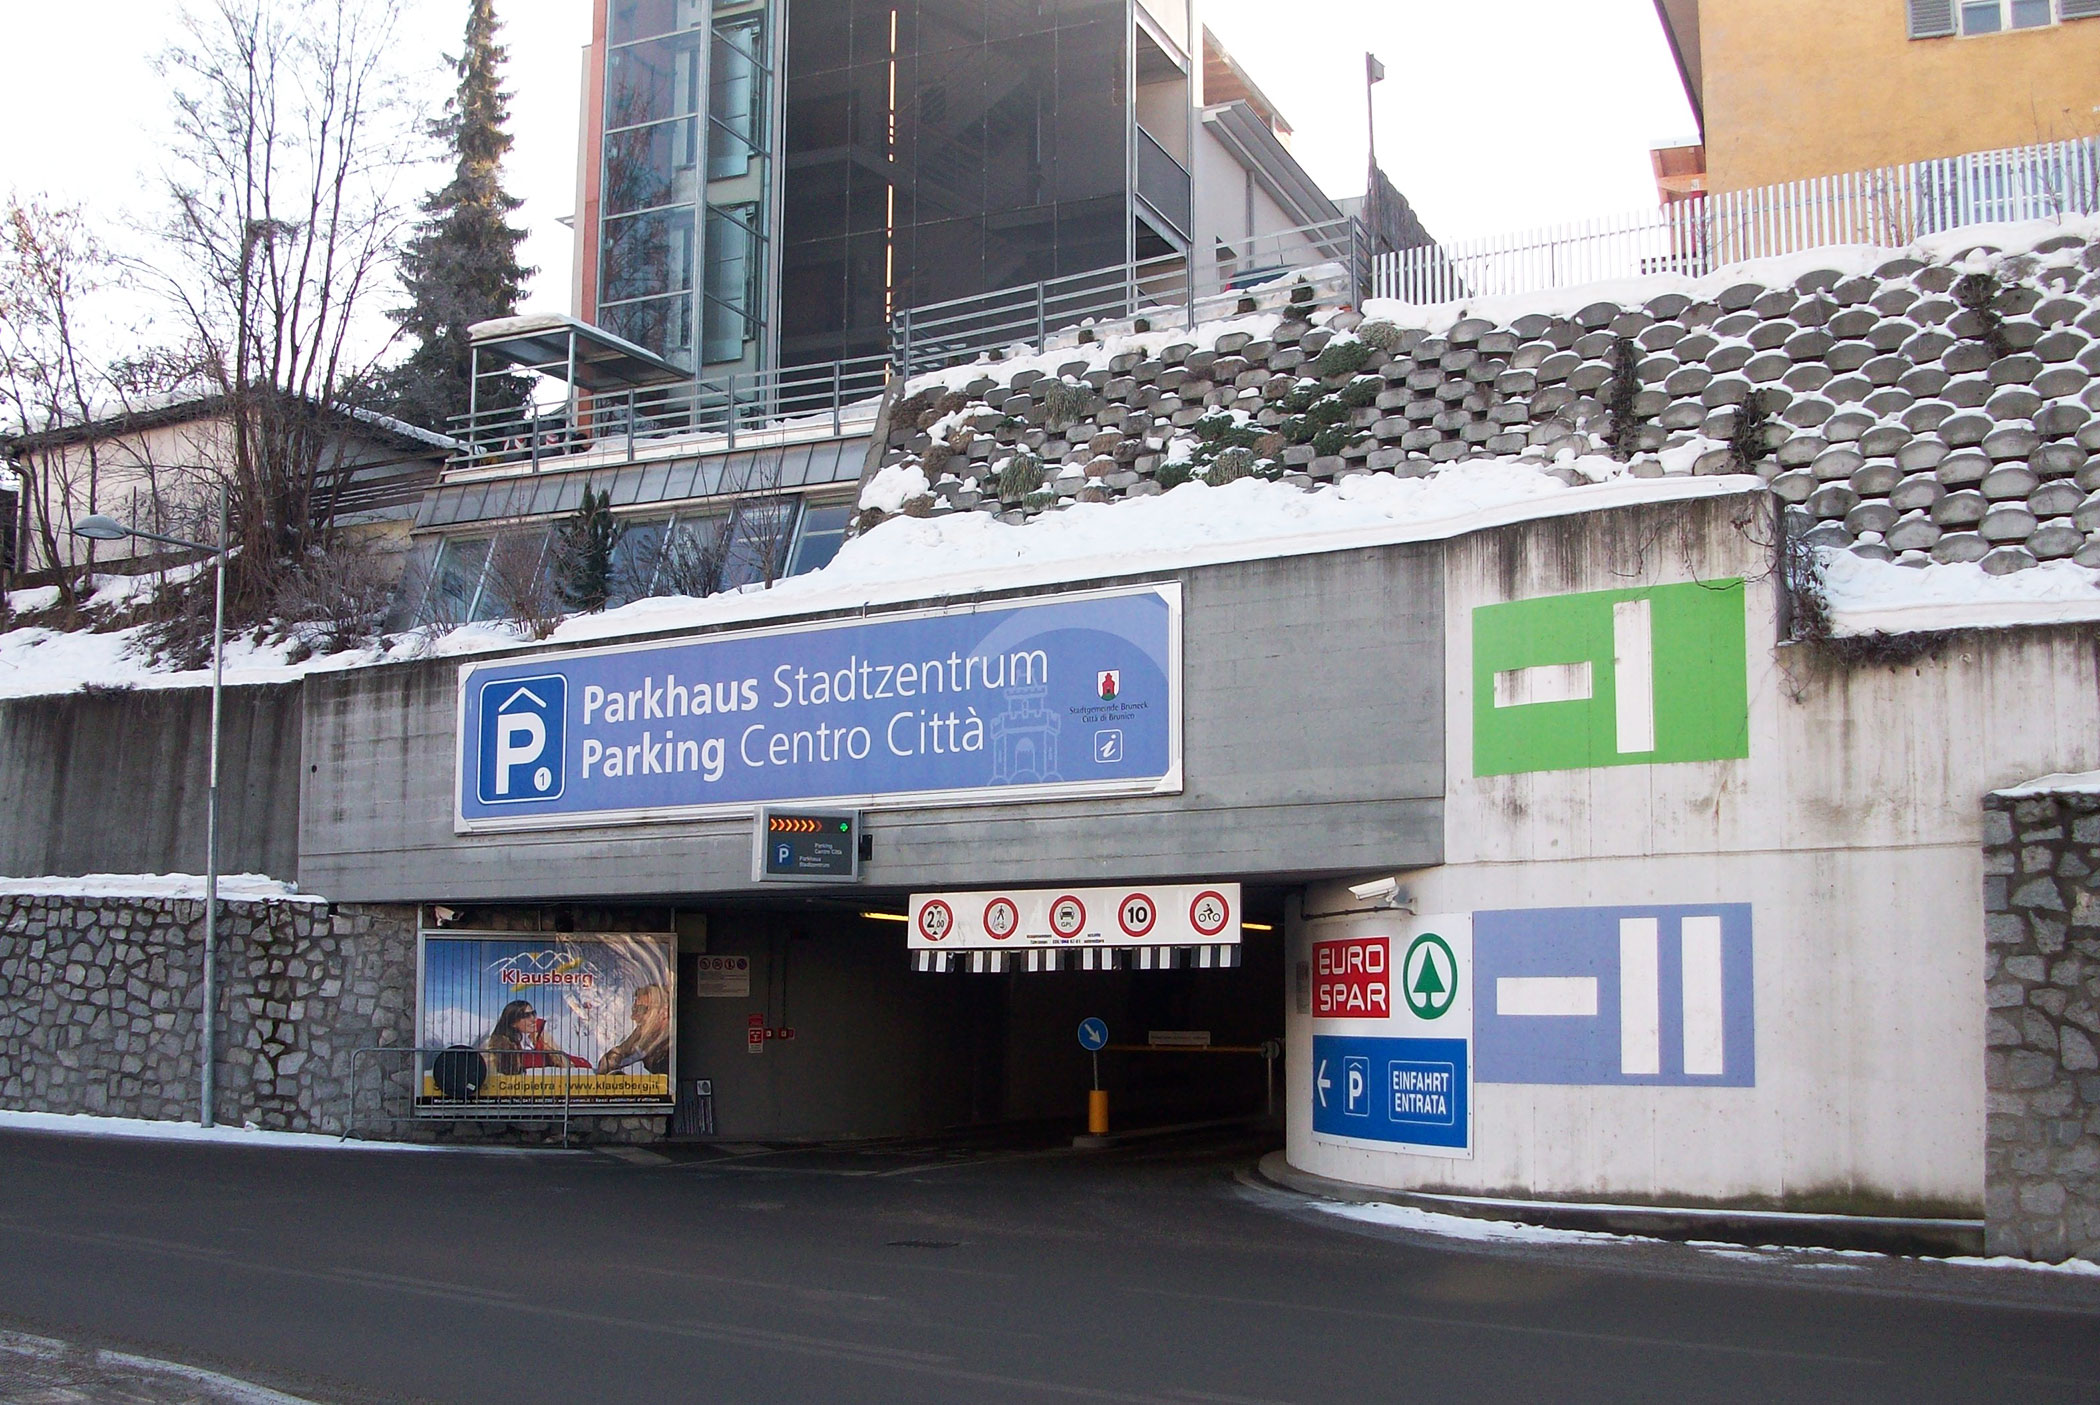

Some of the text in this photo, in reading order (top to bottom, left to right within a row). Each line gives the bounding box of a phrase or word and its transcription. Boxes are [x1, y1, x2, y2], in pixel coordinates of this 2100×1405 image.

[584, 649, 1048, 725] Parkhaus Stadtzentrum
[1069, 701, 1148, 714] Stadtgemeinde Bruneck
[1082, 715, 1098, 723] Città
[1109, 713, 1135, 721] Brunico
[495, 711, 547, 795] P
[582, 706, 984, 782] Parking Centro Città
[779, 847, 789, 864] P
[1127, 906, 1148, 924] 10
[1318, 944, 1385, 975] EURO
[502, 968, 593, 988] Klausberg
[1319, 983, 1387, 1012] SPAR
[499, 1081, 555, 1092] Cadipietra
[1348, 1070, 1363, 1110] P
[1392, 1070, 1450, 1093] EINFAHRT
[1394, 1092, 1447, 1115] ENTRATA
